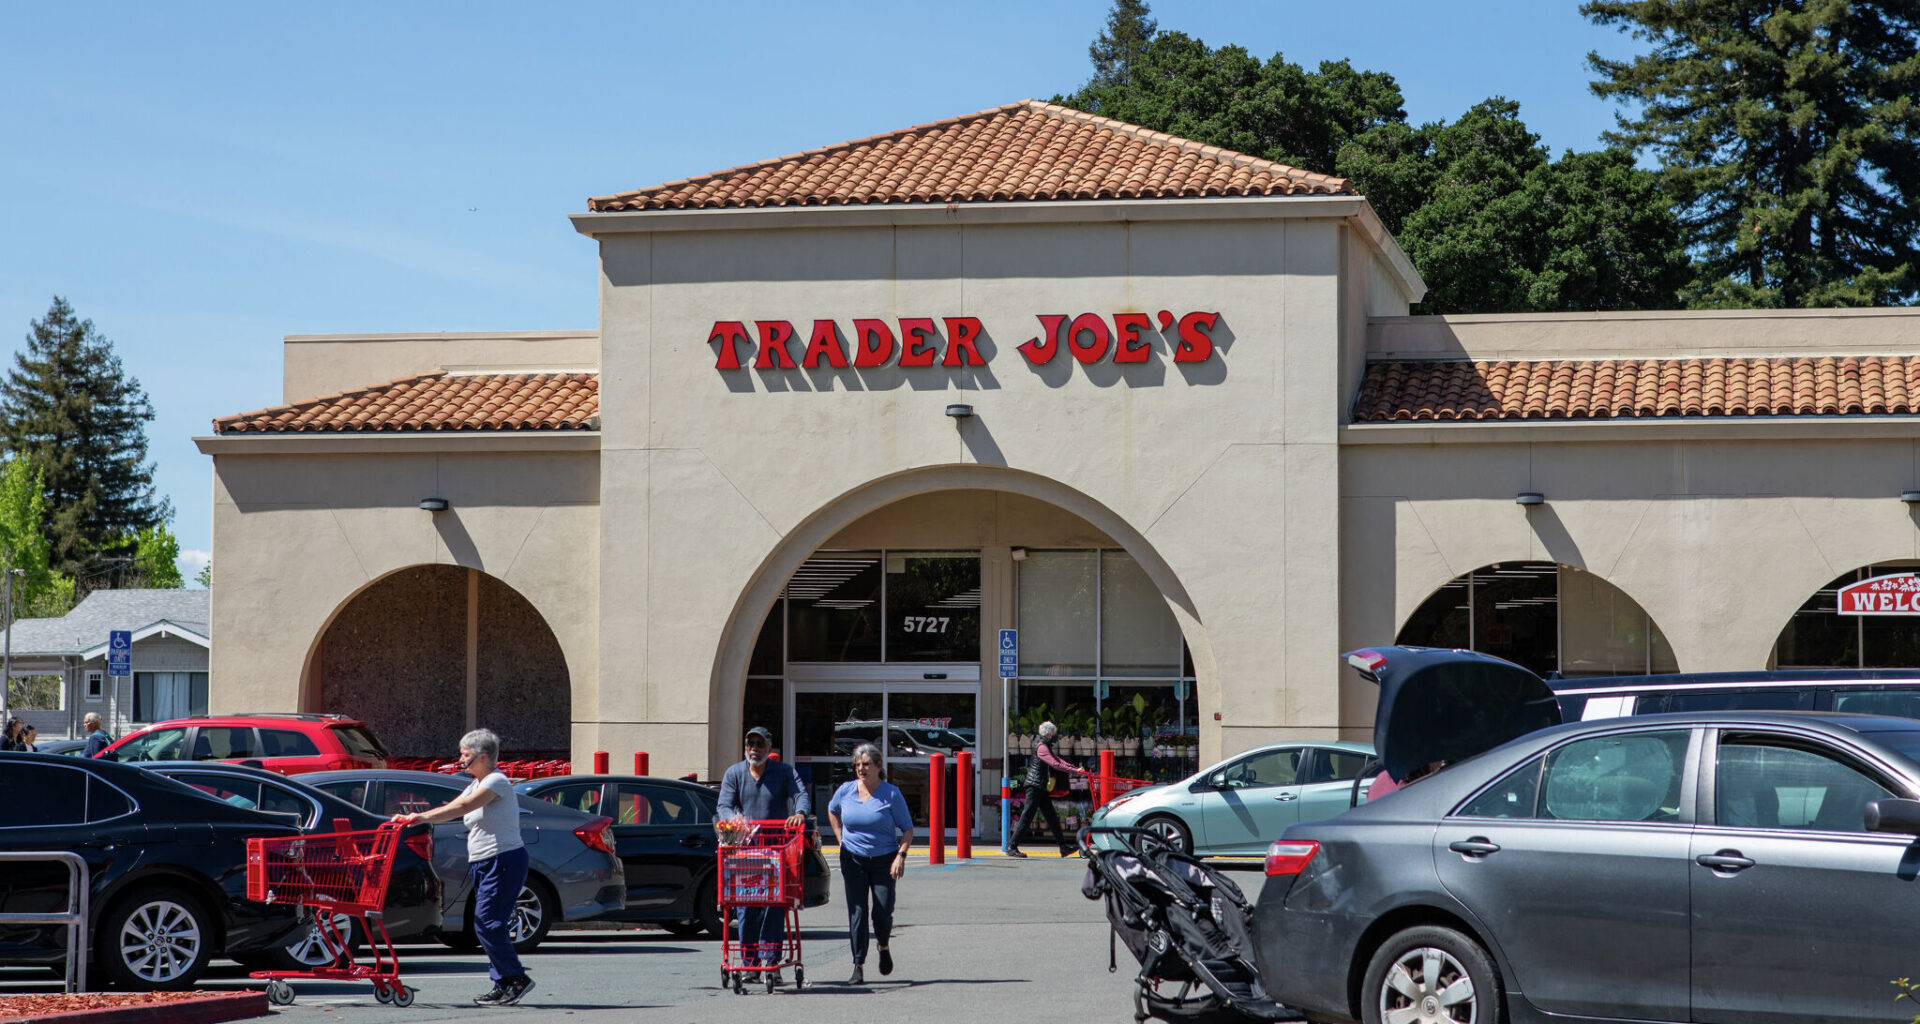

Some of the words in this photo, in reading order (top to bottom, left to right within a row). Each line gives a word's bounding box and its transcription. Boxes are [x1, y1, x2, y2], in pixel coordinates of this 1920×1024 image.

[707, 316, 986, 369] TRADER
[1016, 310, 1220, 365] JOE'S
[904, 616, 950, 633] 5727
[113, 655, 126, 663] ONLY
[1003, 656, 1014, 664] ONLY
[918, 717, 952, 729] EXIT
